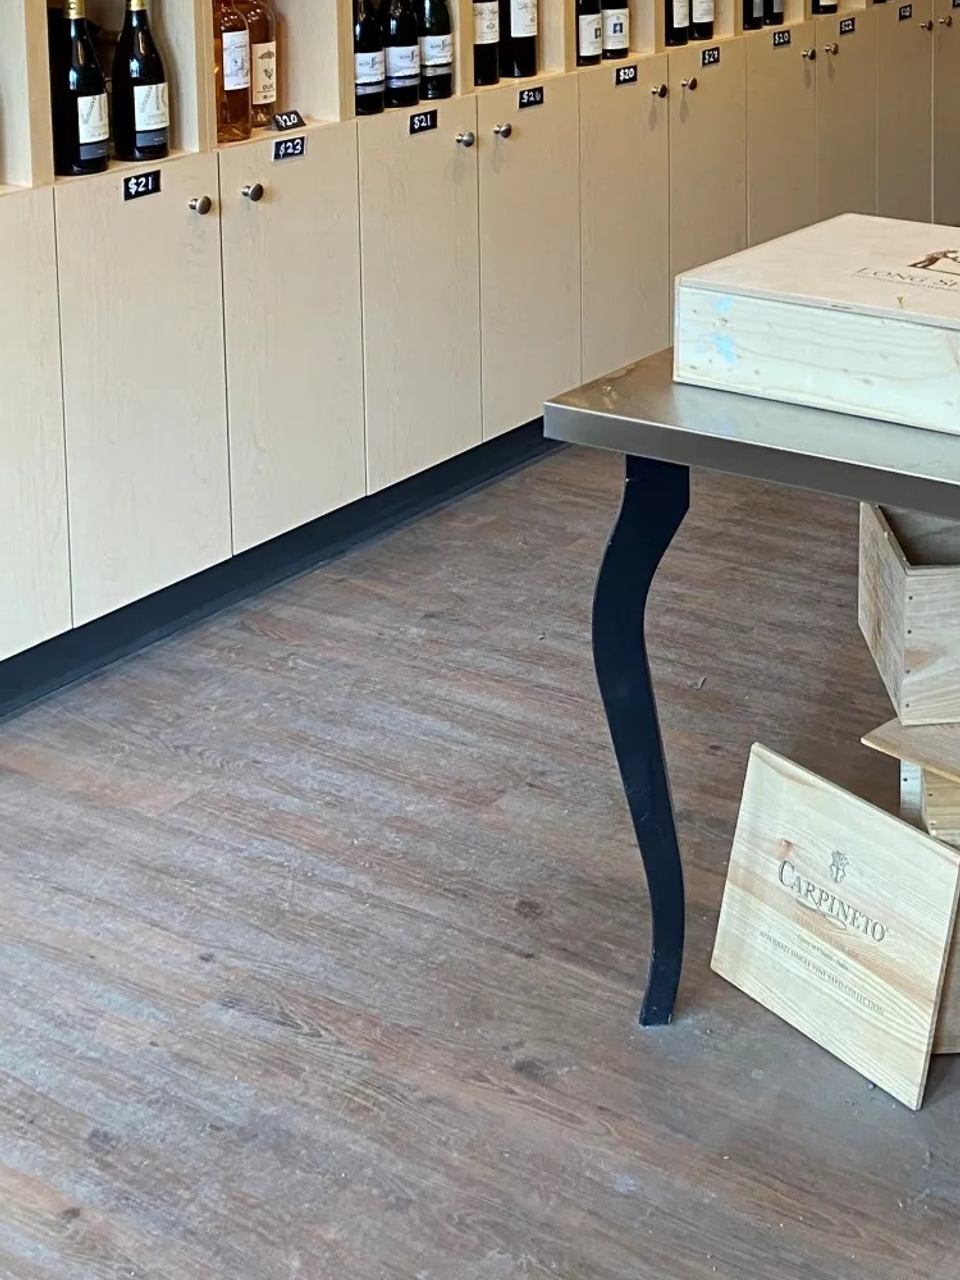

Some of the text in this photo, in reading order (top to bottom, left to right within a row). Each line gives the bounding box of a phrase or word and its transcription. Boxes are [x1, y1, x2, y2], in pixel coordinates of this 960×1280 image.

[774, 32, 789, 45] $20
[620, 67, 635, 81] $20
[413, 113, 431, 130] $21
[278, 138, 302, 159] $23
[128, 176, 153, 196] $21
[856, 267, 929, 284] LONG
[778, 860, 886, 942] CARPINETO
